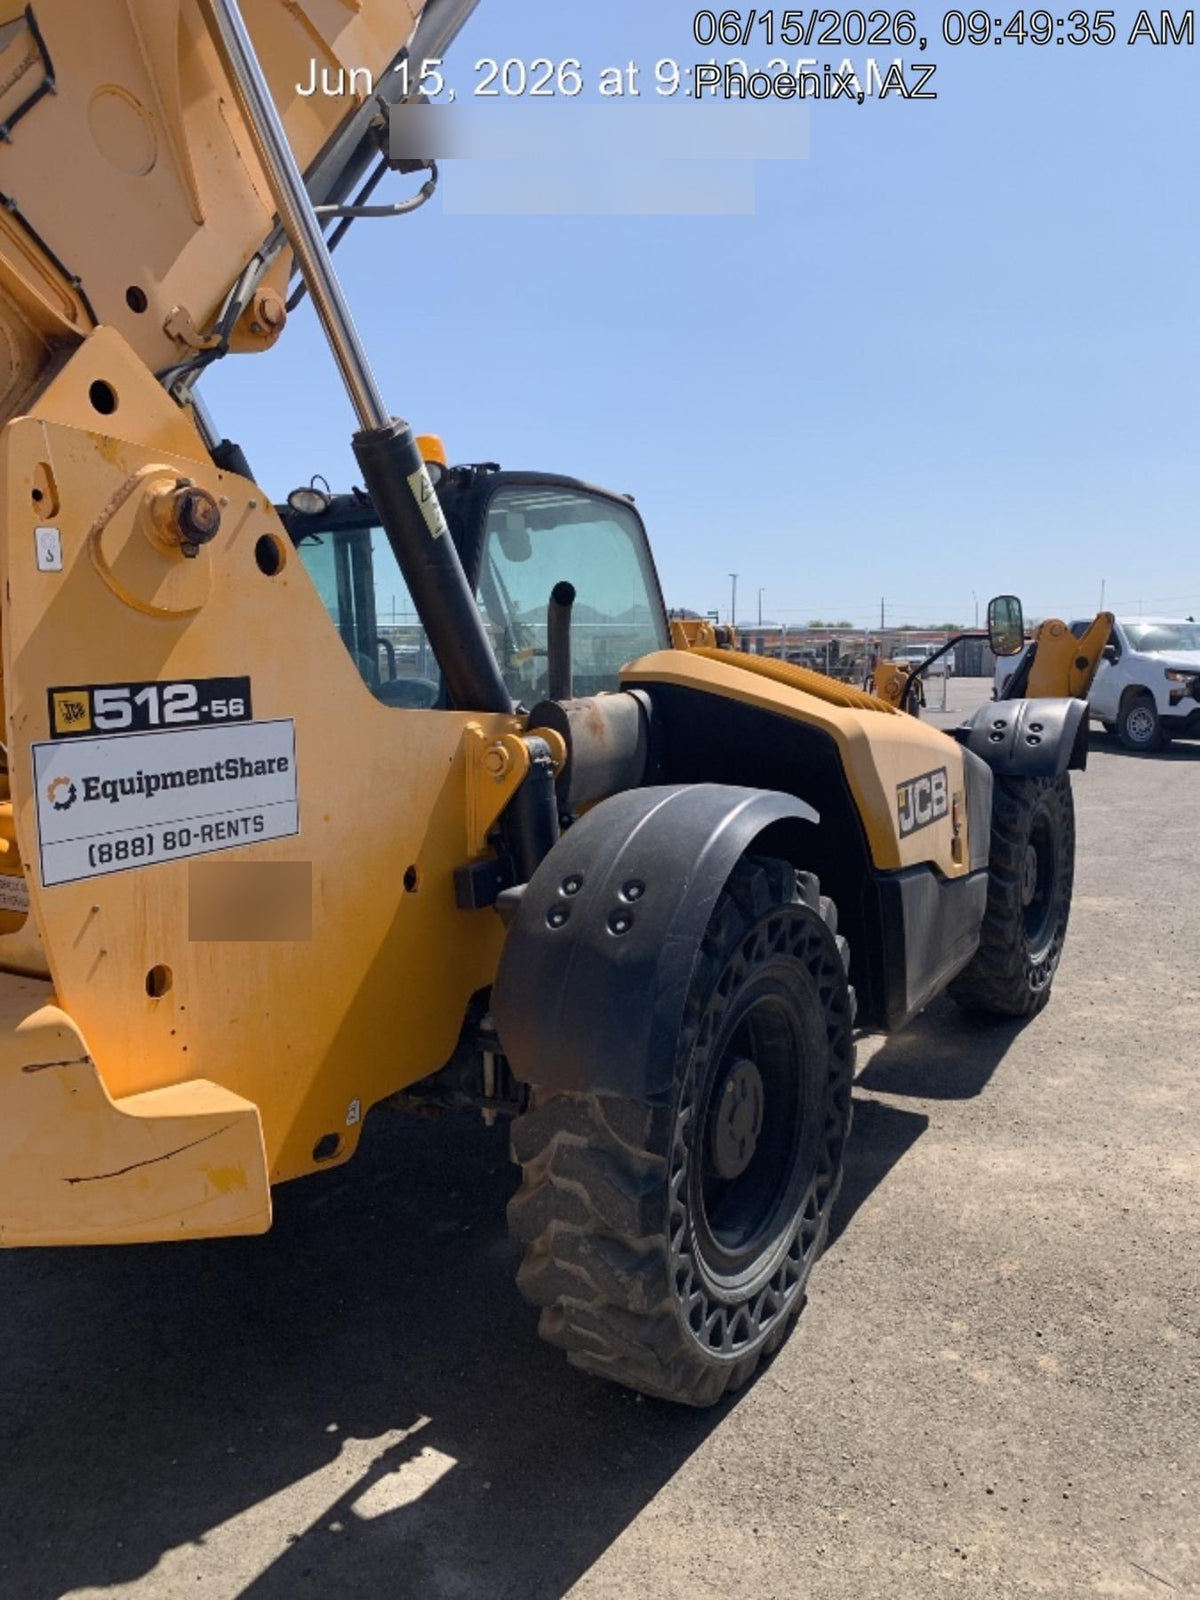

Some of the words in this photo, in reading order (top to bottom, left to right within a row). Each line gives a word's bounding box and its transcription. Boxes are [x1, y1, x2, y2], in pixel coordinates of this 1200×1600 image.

[81, 756, 289, 803] EquipmentShare
[899, 770, 948, 832] JCB
[88, 834, 154, 868] (888)
[162, 815, 265, 851] 80-RENTS
